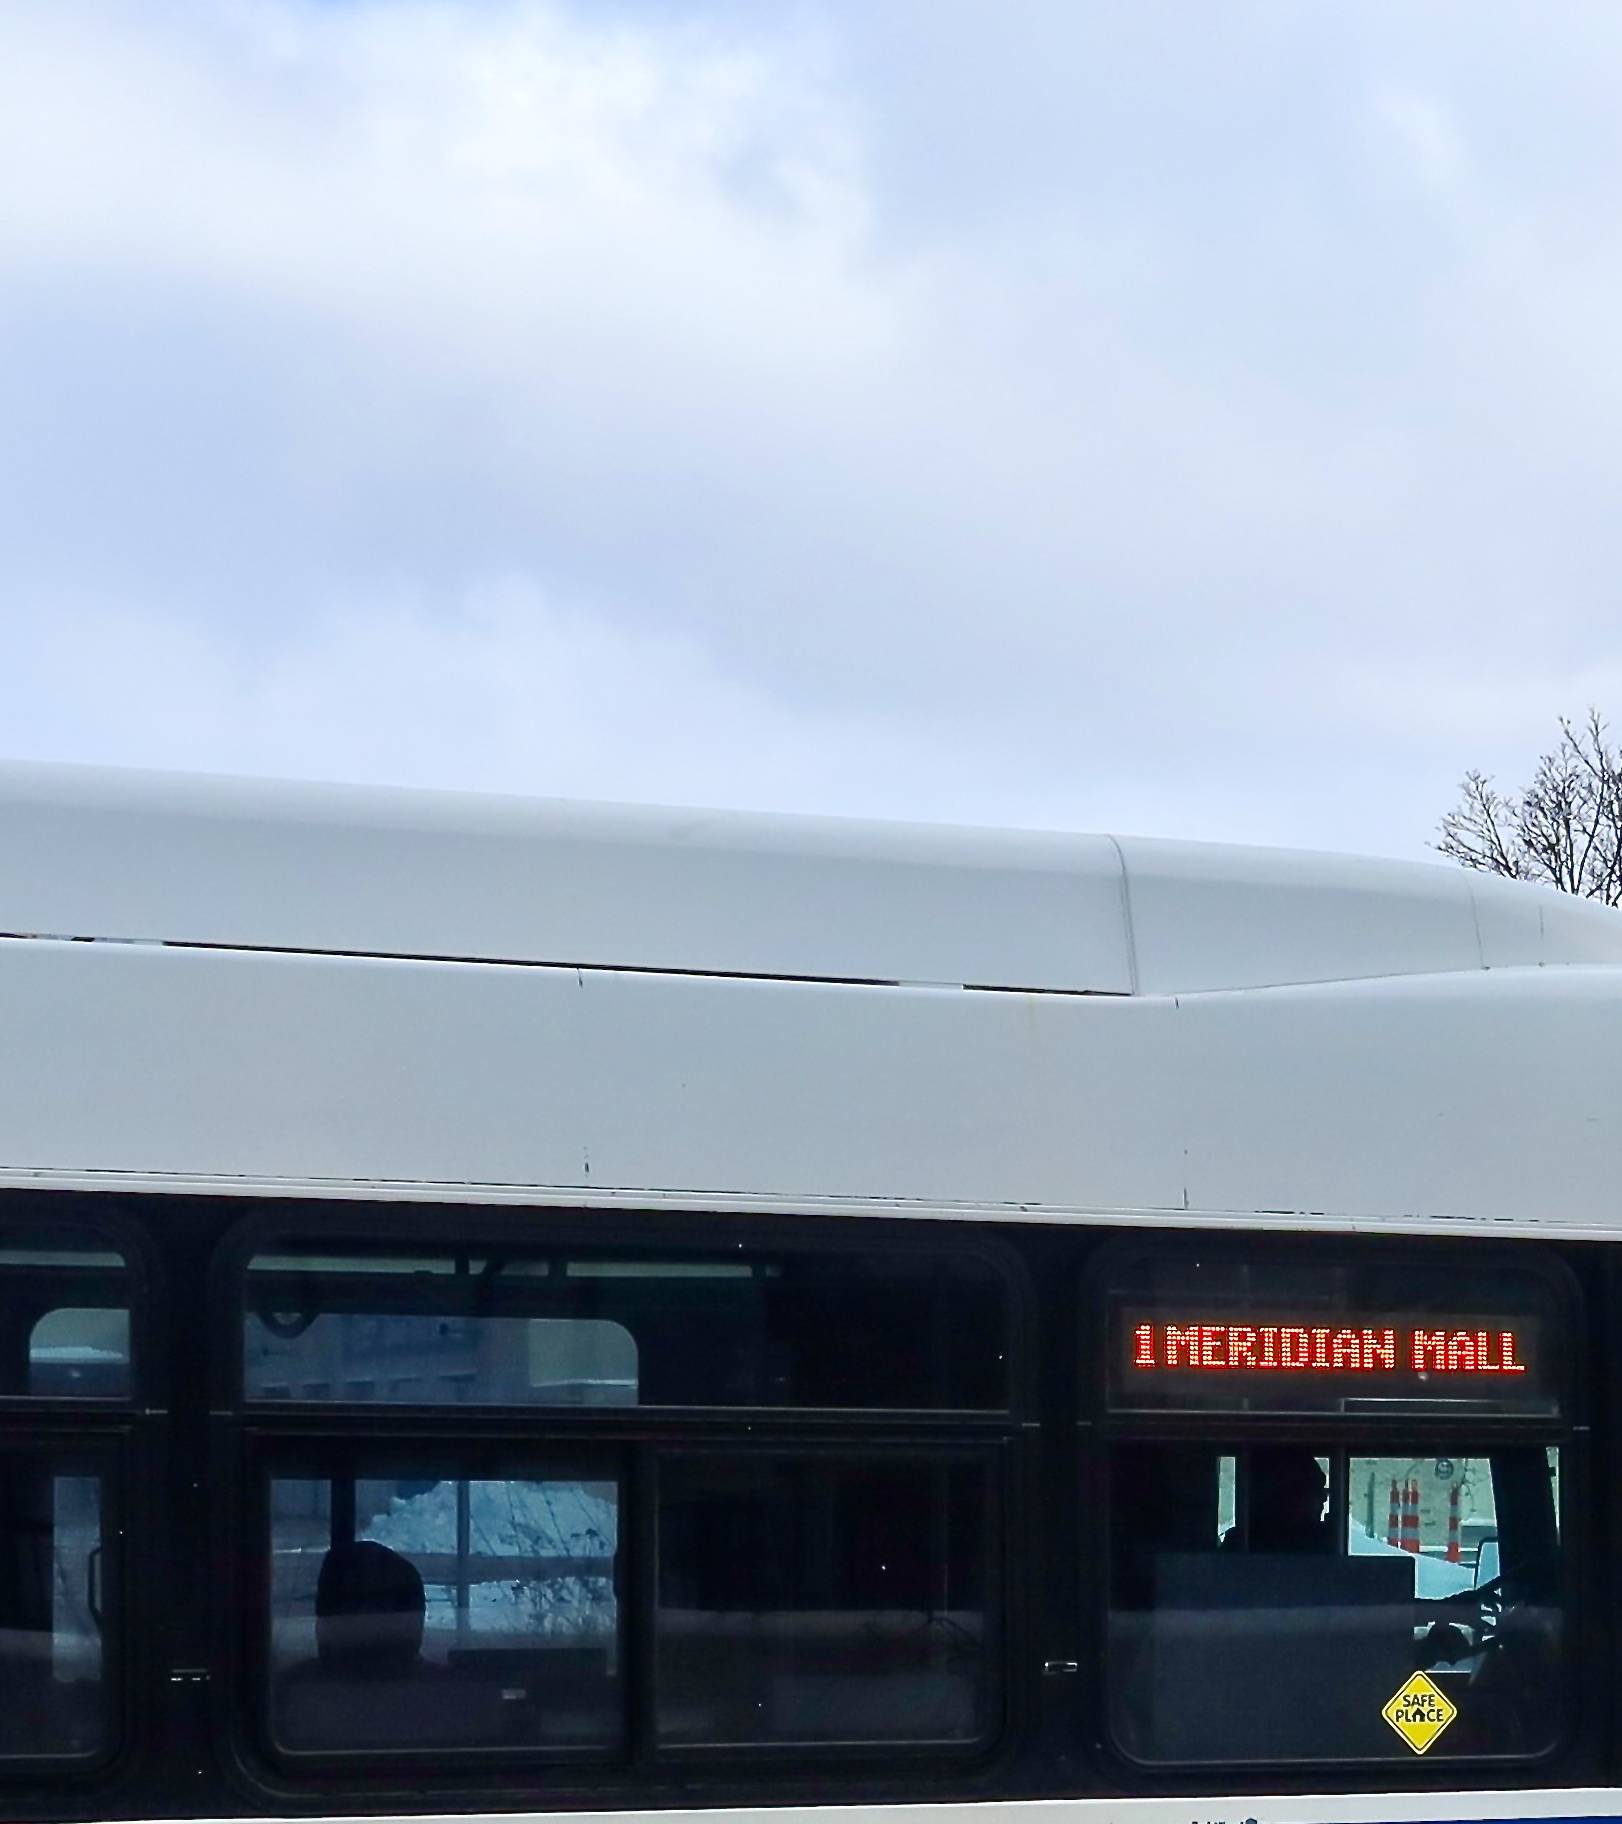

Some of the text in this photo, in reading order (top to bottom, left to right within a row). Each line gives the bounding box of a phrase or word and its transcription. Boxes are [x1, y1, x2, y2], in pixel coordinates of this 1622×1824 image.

[1134, 1323, 1527, 1372] 1 MERIDIAN MALL
[1402, 1693, 1436, 1708] SAFE
